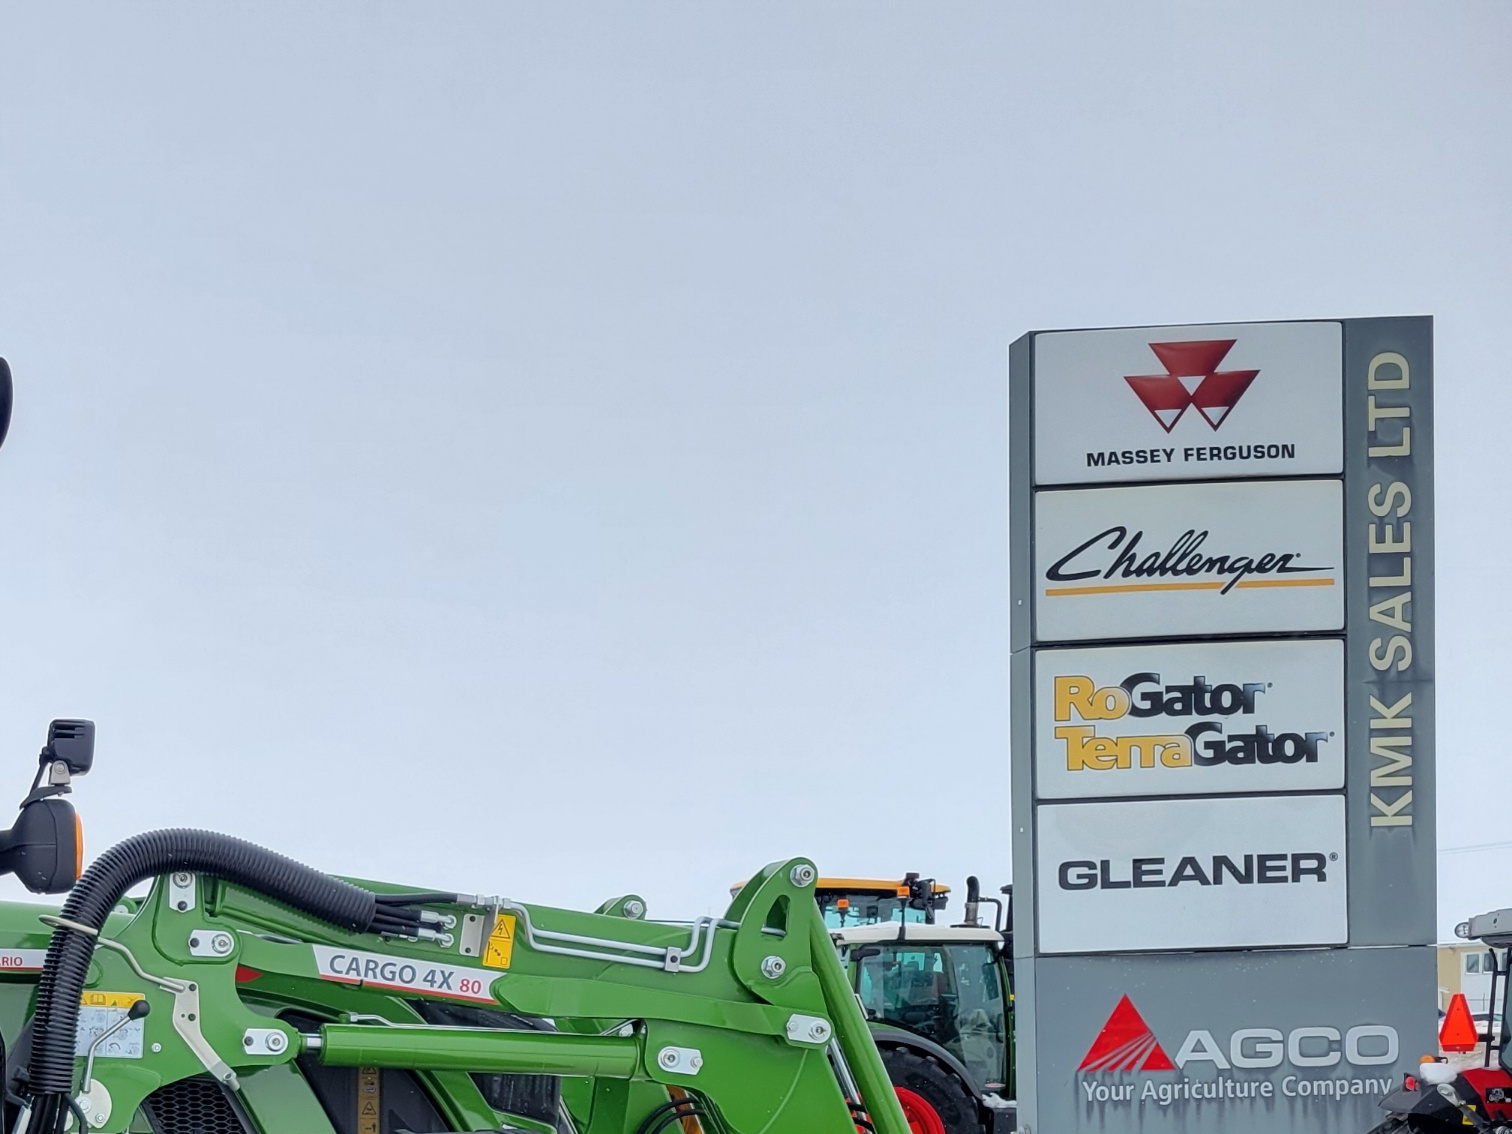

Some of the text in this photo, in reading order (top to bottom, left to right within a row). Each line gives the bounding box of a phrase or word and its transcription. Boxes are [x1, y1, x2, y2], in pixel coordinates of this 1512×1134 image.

[1086, 443, 1296, 467] MASSEY FERGUSON
[1045, 525, 1335, 595] Challenger
[1368, 351, 1413, 827] KMK SALES LTD
[1054, 671, 1266, 721] RoGator
[1054, 721, 1329, 771] TerraGator
[329, 954, 482, 995] CARGO 4X 80
[1174, 1025, 1399, 1070] AGCO
[1082, 1075, 1393, 1106] Your Agriculture Company
